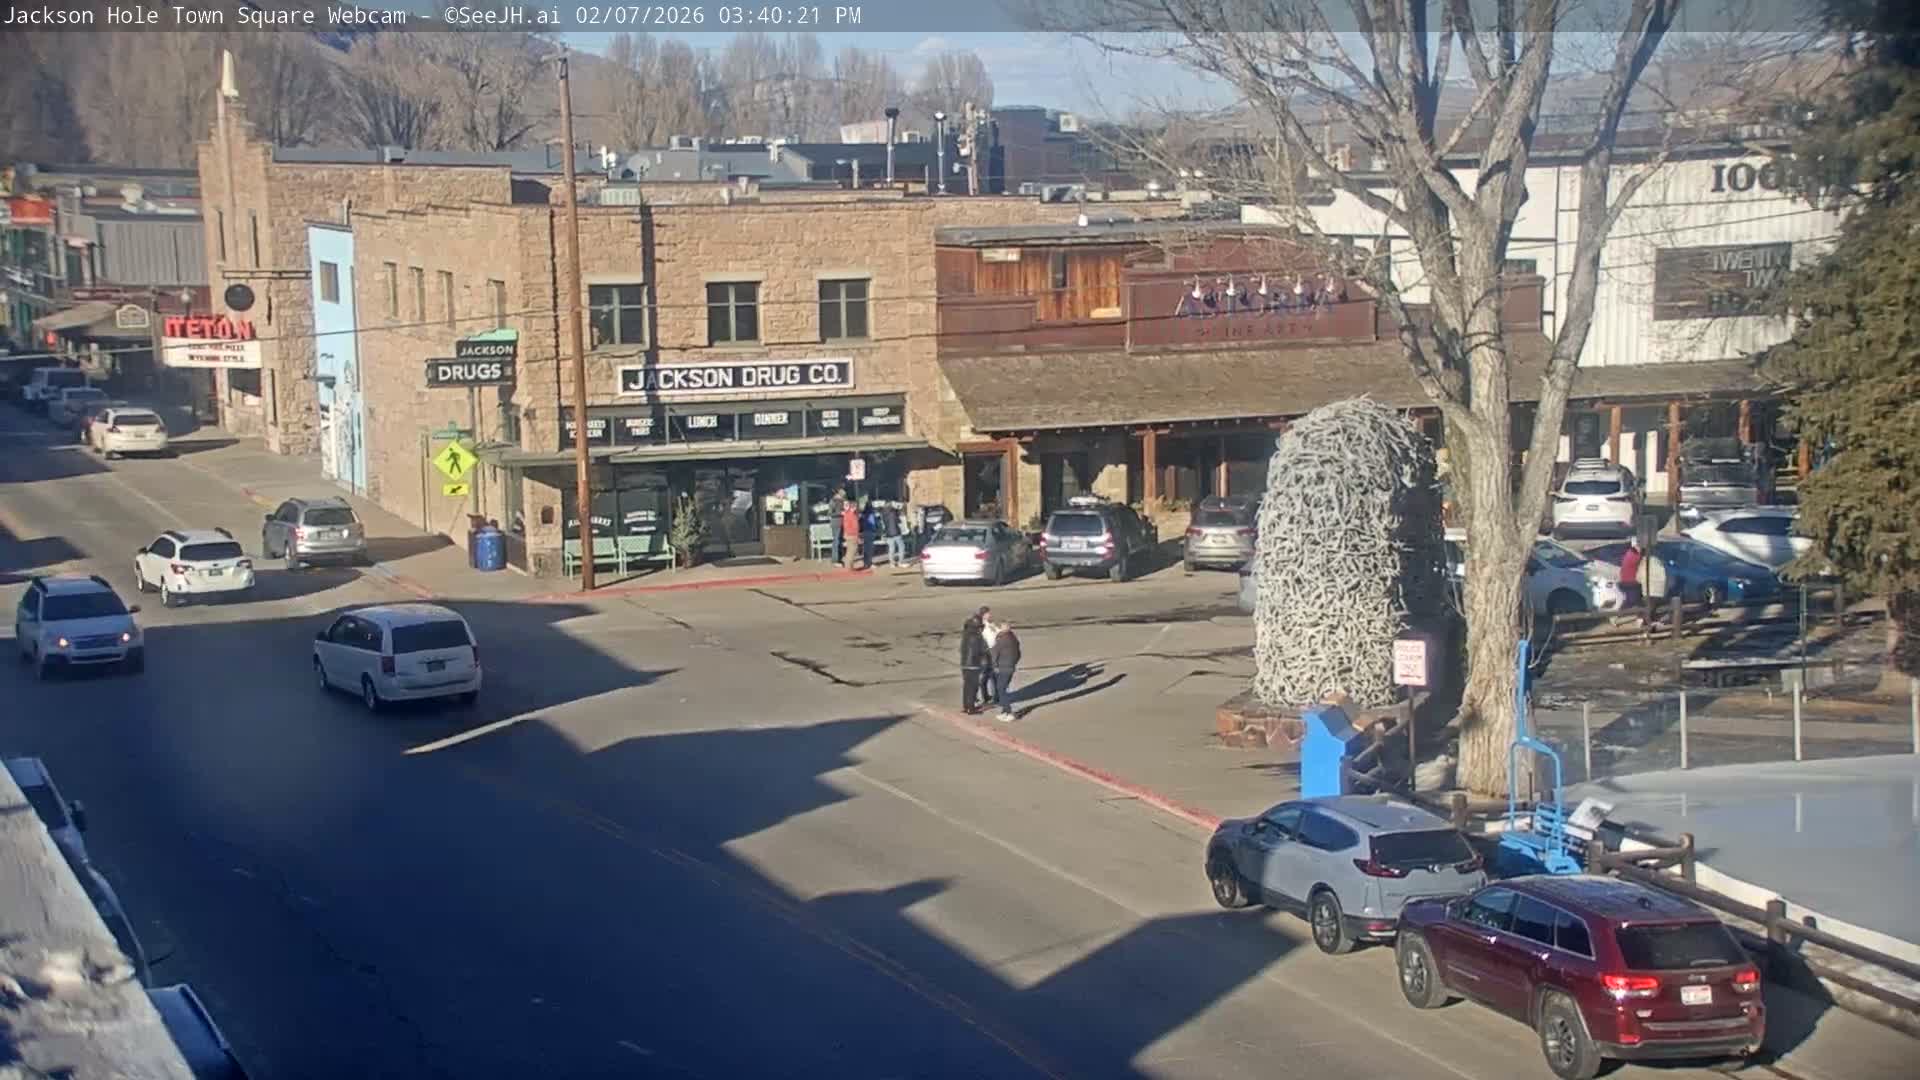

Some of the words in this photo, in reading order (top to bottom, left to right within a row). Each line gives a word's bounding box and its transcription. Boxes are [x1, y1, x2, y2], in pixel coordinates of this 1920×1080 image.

[164, 317, 253, 341] TETON
[460, 344, 514, 357] JACKSON
[438, 363, 502, 382] DRUGS
[628, 367, 734, 391] JACKSON
[742, 365, 800, 387] DRUG
[809, 363, 843, 384] CO.
[687, 415, 718, 429] LUNCH
[754, 412, 789, 426] DINNER
